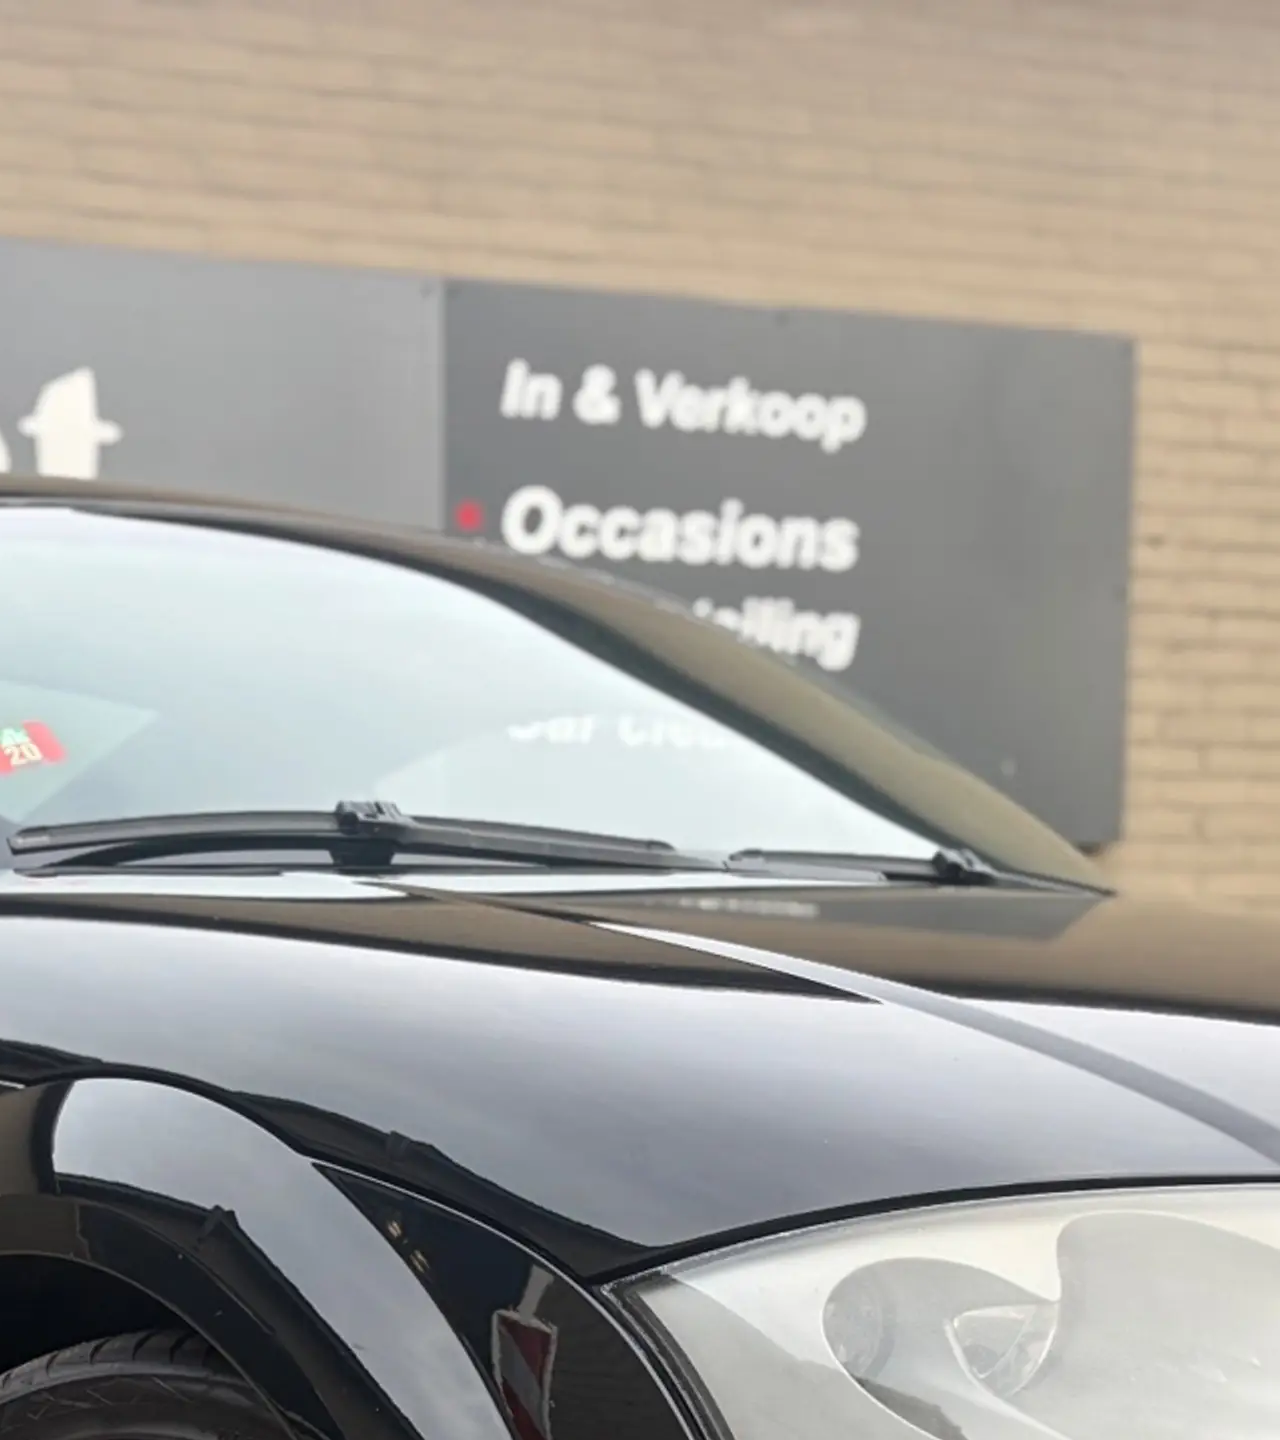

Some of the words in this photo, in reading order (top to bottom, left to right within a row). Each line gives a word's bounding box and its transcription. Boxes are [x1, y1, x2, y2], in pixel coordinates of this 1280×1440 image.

[499, 356, 563, 421] In
[572, 363, 622, 426] &
[634, 367, 868, 454] Verkoop
[500, 484, 861, 574] Occasions
